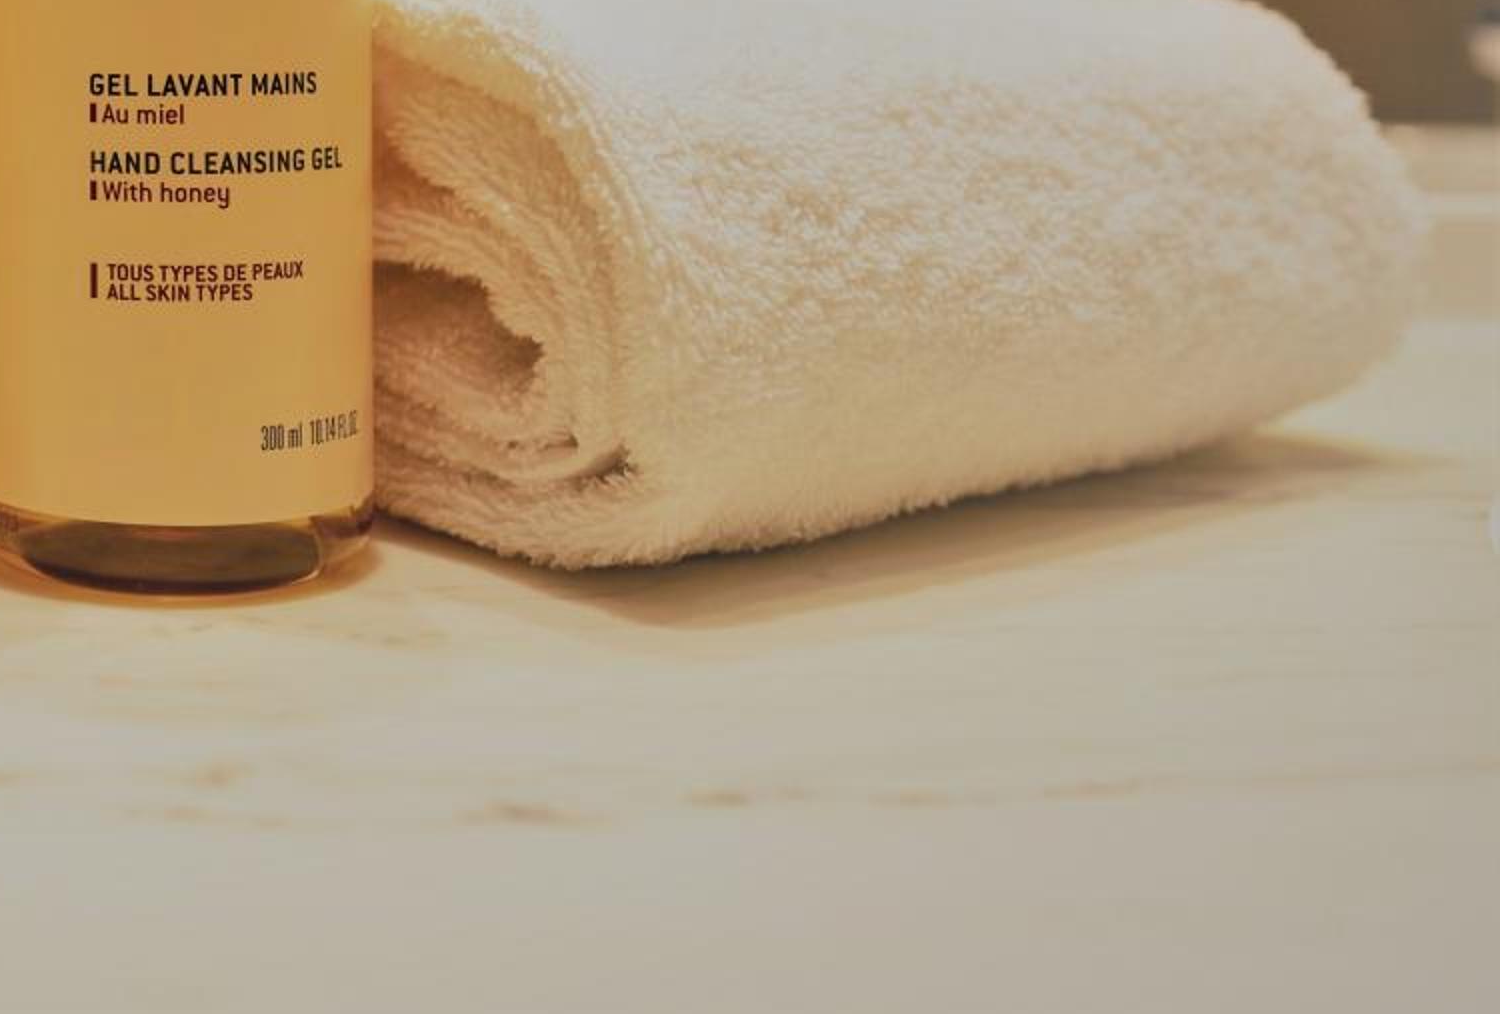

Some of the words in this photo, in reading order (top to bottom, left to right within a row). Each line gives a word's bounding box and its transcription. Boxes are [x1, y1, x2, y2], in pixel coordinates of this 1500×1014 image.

[89, 73, 139, 97] GEL
[147, 73, 243, 98] LAVANT
[251, 71, 317, 97] MAINS
[101, 102, 129, 125] Au
[136, 103, 185, 126] miel
[89, 150, 161, 176] HAND
[169, 148, 306, 176] CLEANSING
[311, 146, 343, 171] GEL
[101, 180, 153, 203] With
[159, 181, 231, 211] honey
[106, 262, 155, 283] TOUS
[158, 264, 219, 283] TYPES
[223, 263, 248, 283] DE
[250, 259, 304, 282] PEAUX
[105, 283, 142, 302] ALL
[145, 283, 191, 303] SKIN
[195, 282, 254, 303] TYPES
[260, 423, 286, 452] 300
[287, 421, 304, 449] ml
